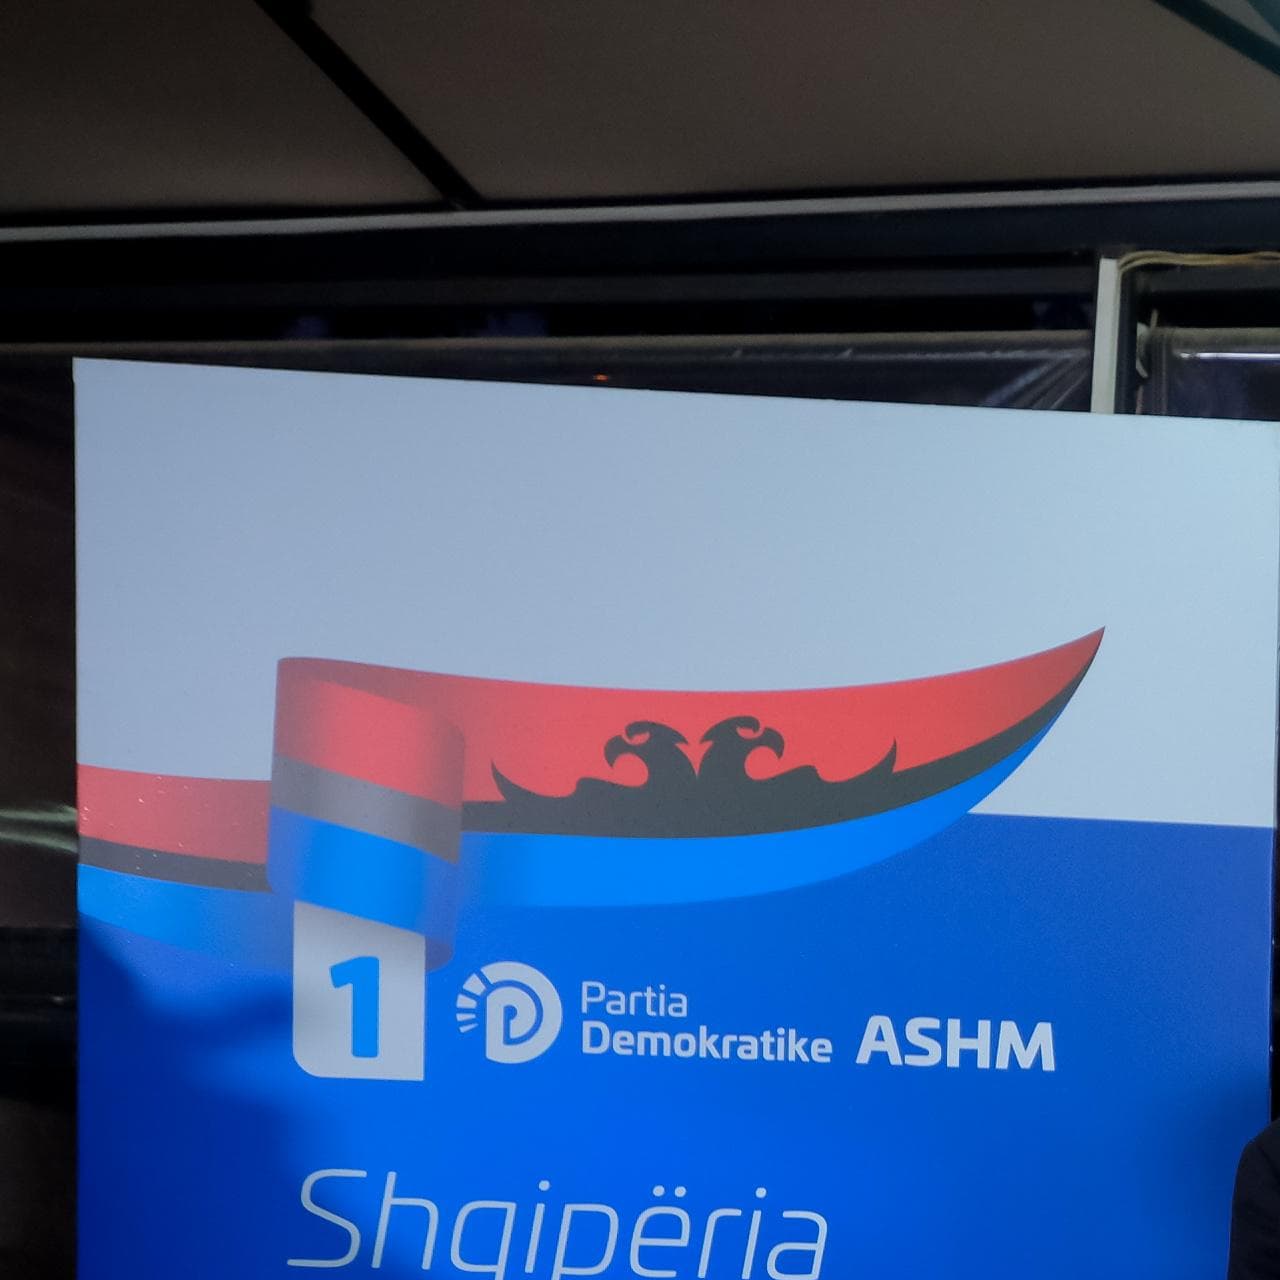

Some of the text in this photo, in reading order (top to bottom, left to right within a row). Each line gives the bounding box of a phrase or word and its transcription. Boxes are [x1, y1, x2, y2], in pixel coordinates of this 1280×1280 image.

[330, 956, 379, 1058] 1
[581, 981, 688, 1017] Partia
[582, 1020, 832, 1063] Demokratike
[855, 1015, 1056, 1072] ASHM
